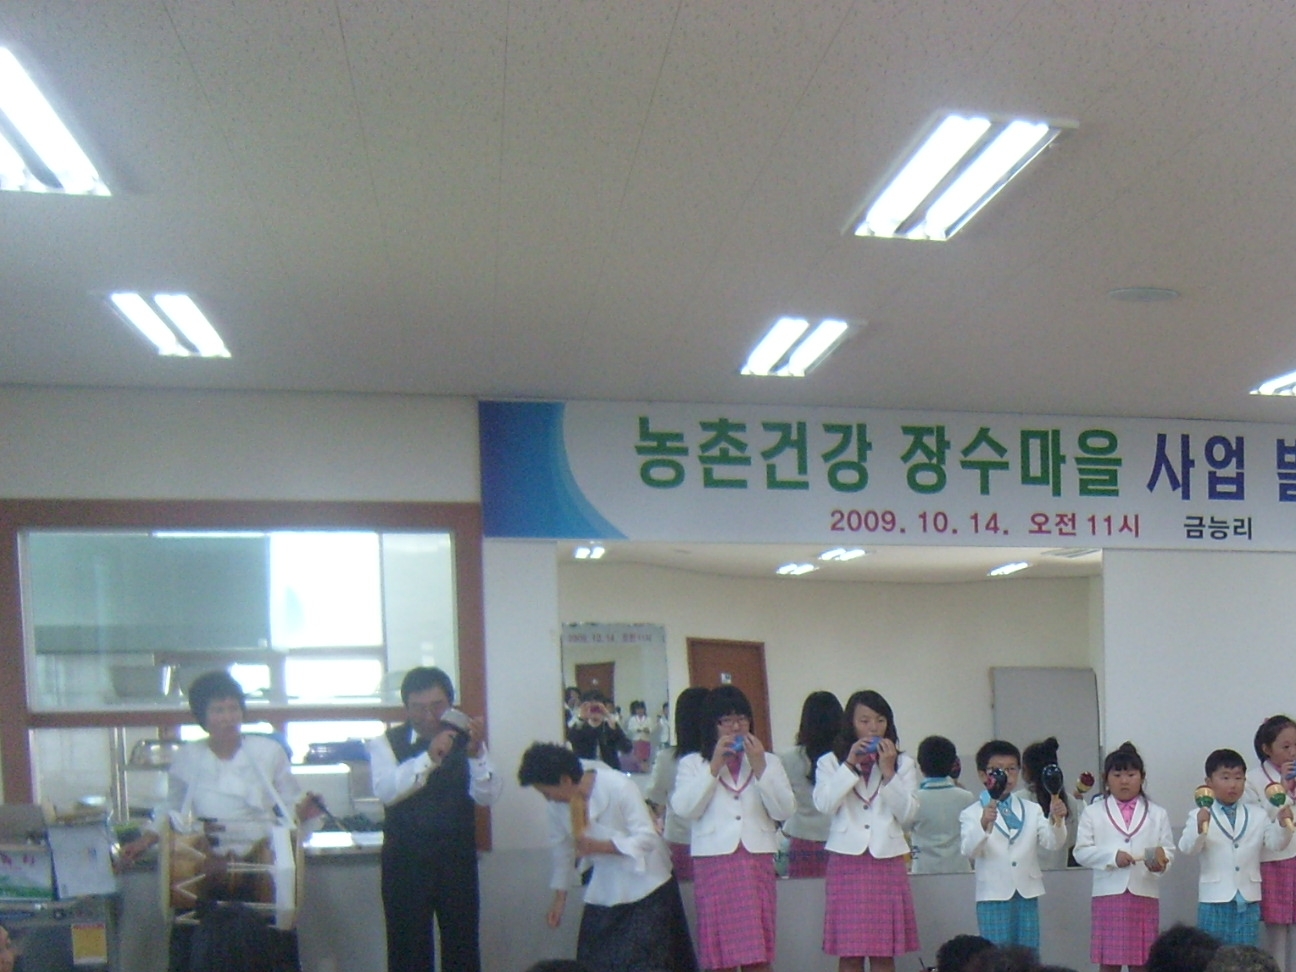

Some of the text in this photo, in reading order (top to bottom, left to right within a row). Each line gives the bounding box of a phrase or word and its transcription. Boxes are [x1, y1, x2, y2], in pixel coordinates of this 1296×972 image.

[634, 416, 873, 494] 농촌건강
[899, 425, 1123, 497] 장수마을
[1146, 433, 1245, 501] 사업
[830, 509, 1140, 538] 2009. 10. 14. 오전 11시
[1183, 516, 1253, 540] 금능리
